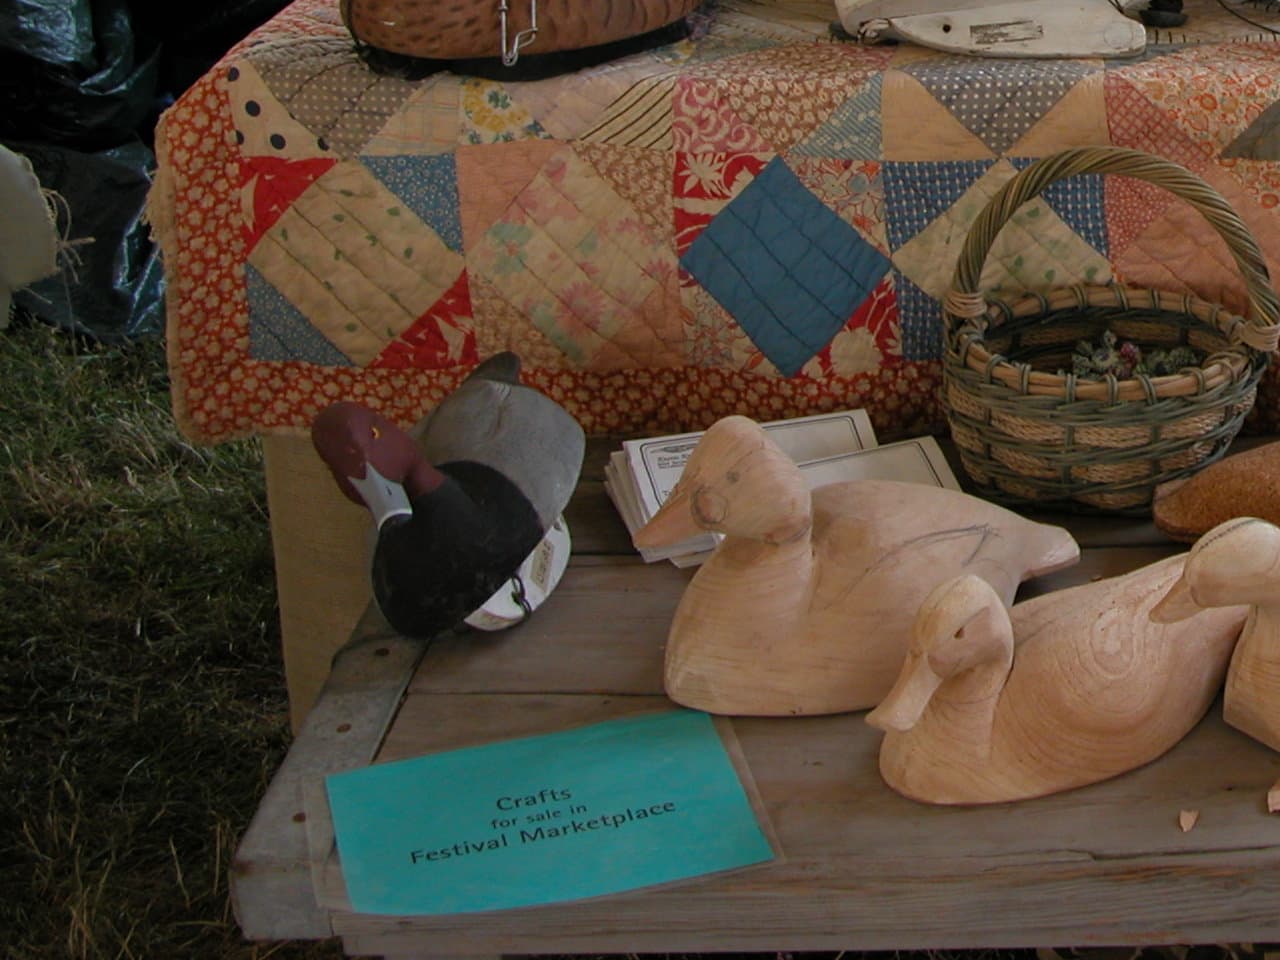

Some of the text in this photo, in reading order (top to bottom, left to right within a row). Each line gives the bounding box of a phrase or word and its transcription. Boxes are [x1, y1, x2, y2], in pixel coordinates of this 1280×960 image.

[496, 788, 573, 811] Crafts
[491, 804, 588, 830] for sale in
[410, 800, 677, 864] Festival Marketplace
